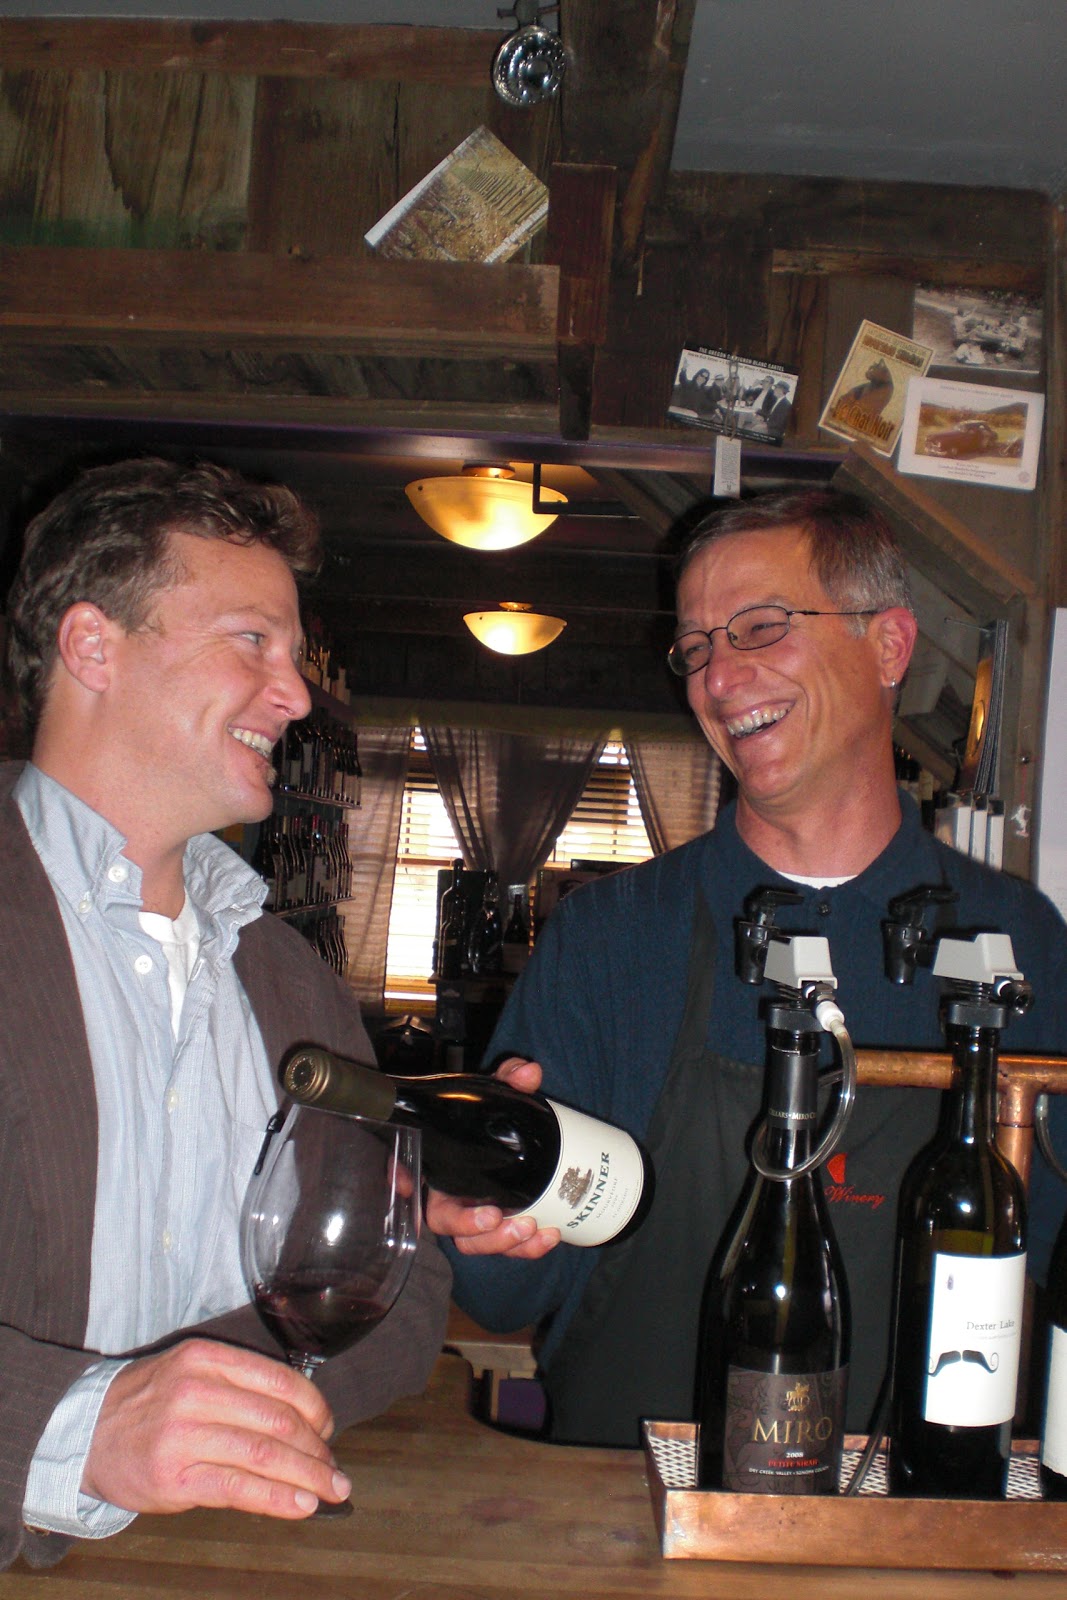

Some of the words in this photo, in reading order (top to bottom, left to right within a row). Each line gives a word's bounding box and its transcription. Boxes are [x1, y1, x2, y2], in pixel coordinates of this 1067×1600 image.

[566, 1151, 610, 1229] SKINNER
[824, 1184, 885, 1210] Winery
[966, 1321, 997, 1331] Dexter
[1000, 1319, 1015, 1329] Lake
[753, 1416, 833, 1444] MIRO
[768, 1459, 794, 1469] PETITE
